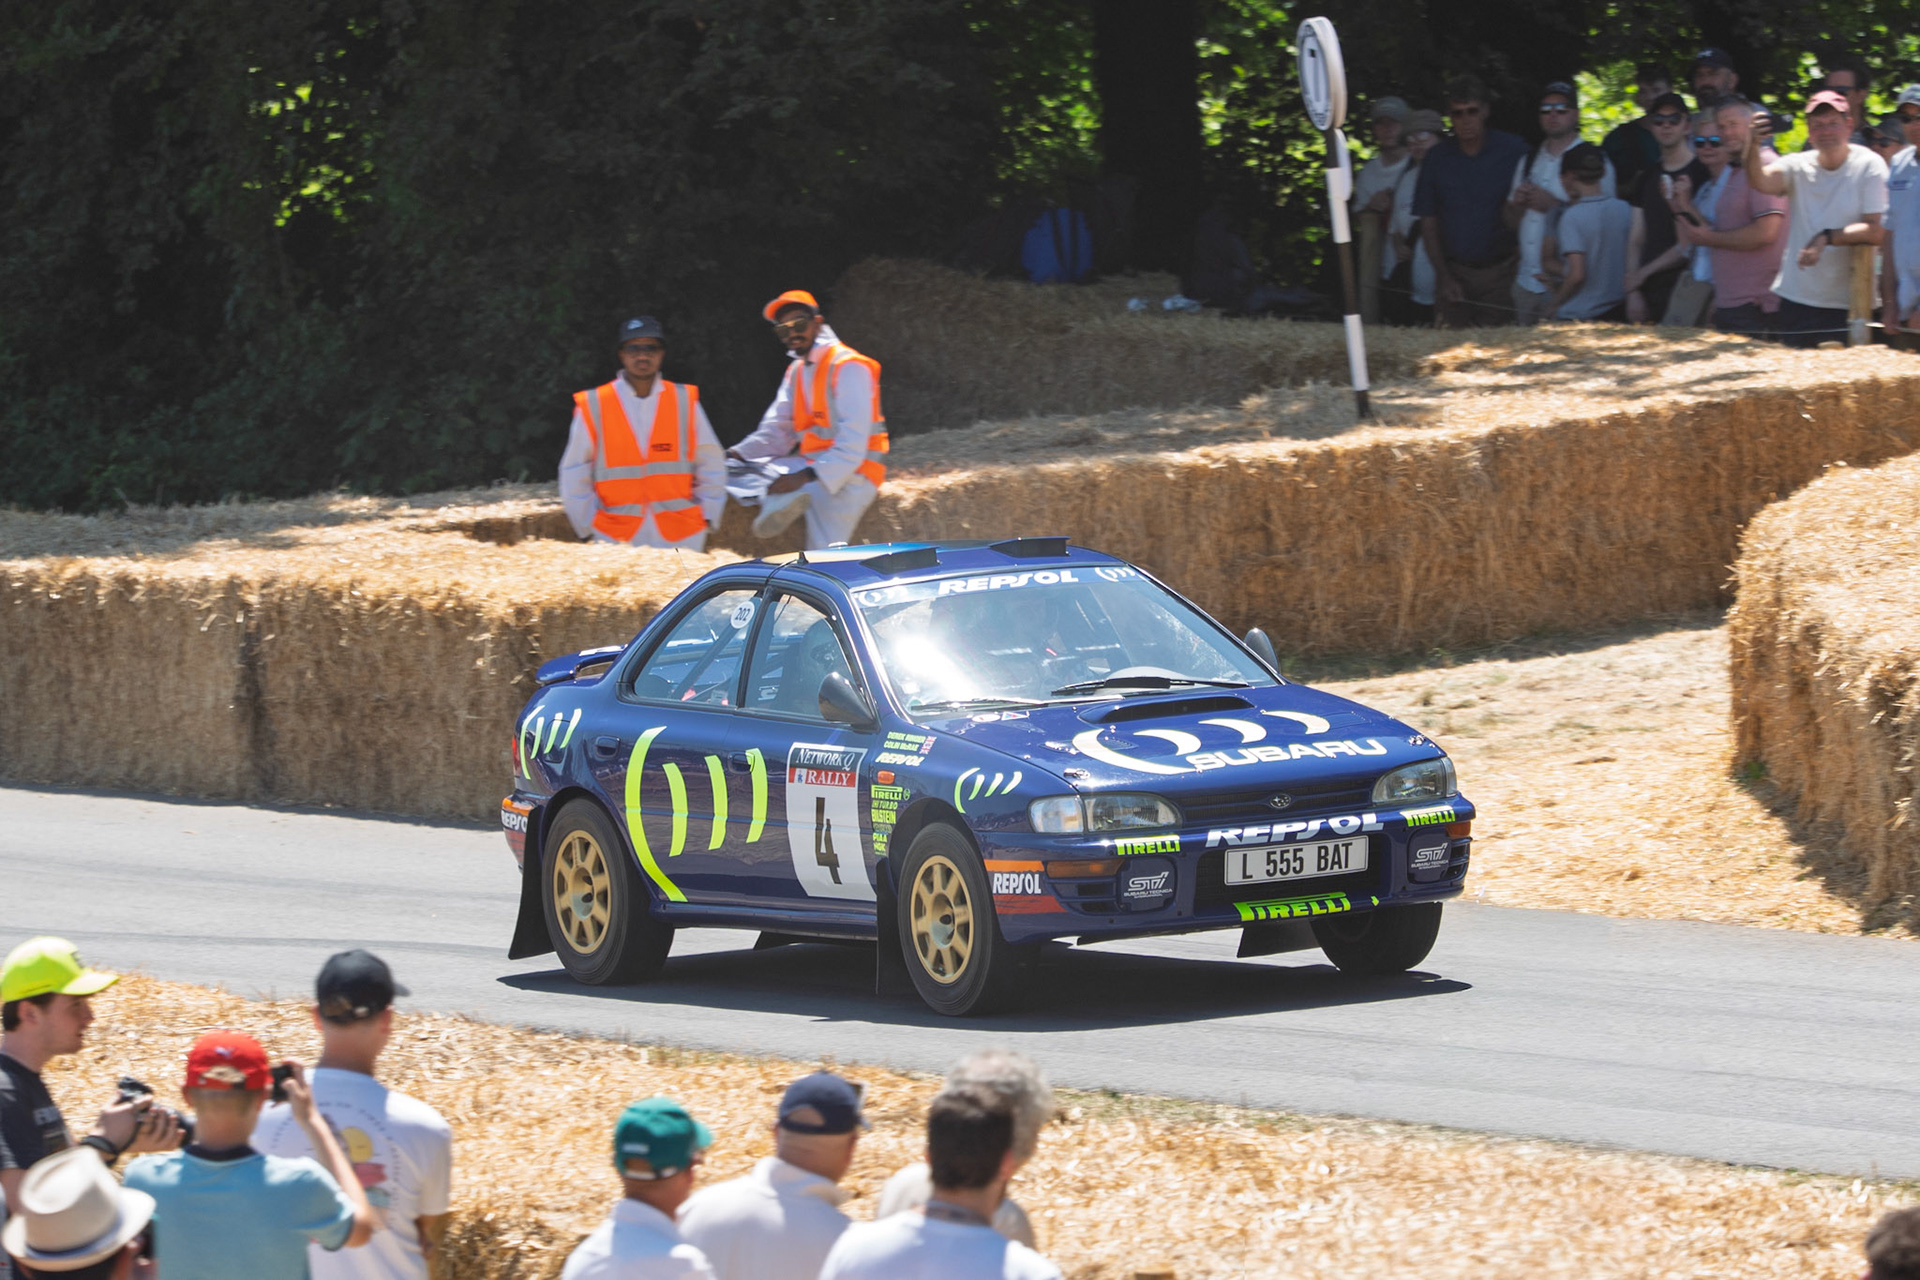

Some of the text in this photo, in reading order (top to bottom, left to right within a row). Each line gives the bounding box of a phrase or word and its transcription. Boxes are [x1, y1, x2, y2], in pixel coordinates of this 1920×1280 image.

[938, 570, 1079, 595] REPSOL
[734, 607, 751, 621] 202
[796, 748, 842, 766] NETWORK
[875, 752, 925, 767] REPSOL
[1185, 739, 1388, 771] SUBARU
[807, 770, 851, 786] RALLY
[871, 784, 903, 801] PIRELLI
[879, 801, 898, 810] TURBO
[871, 808, 897, 824] BILSTEIN
[1400, 805, 1456, 827] PIRELLI
[872, 832, 888, 842] PIAA
[1205, 812, 1384, 848] REPSOL
[815, 796, 842, 885] 4
[1114, 834, 1181, 856] PIRELLI
[1242, 842, 1353, 880] L 555 BAT
[992, 872, 1042, 895] REPSOL
[1123, 890, 1149, 898] SUBARU
[1233, 892, 1351, 922] PIRELLI
